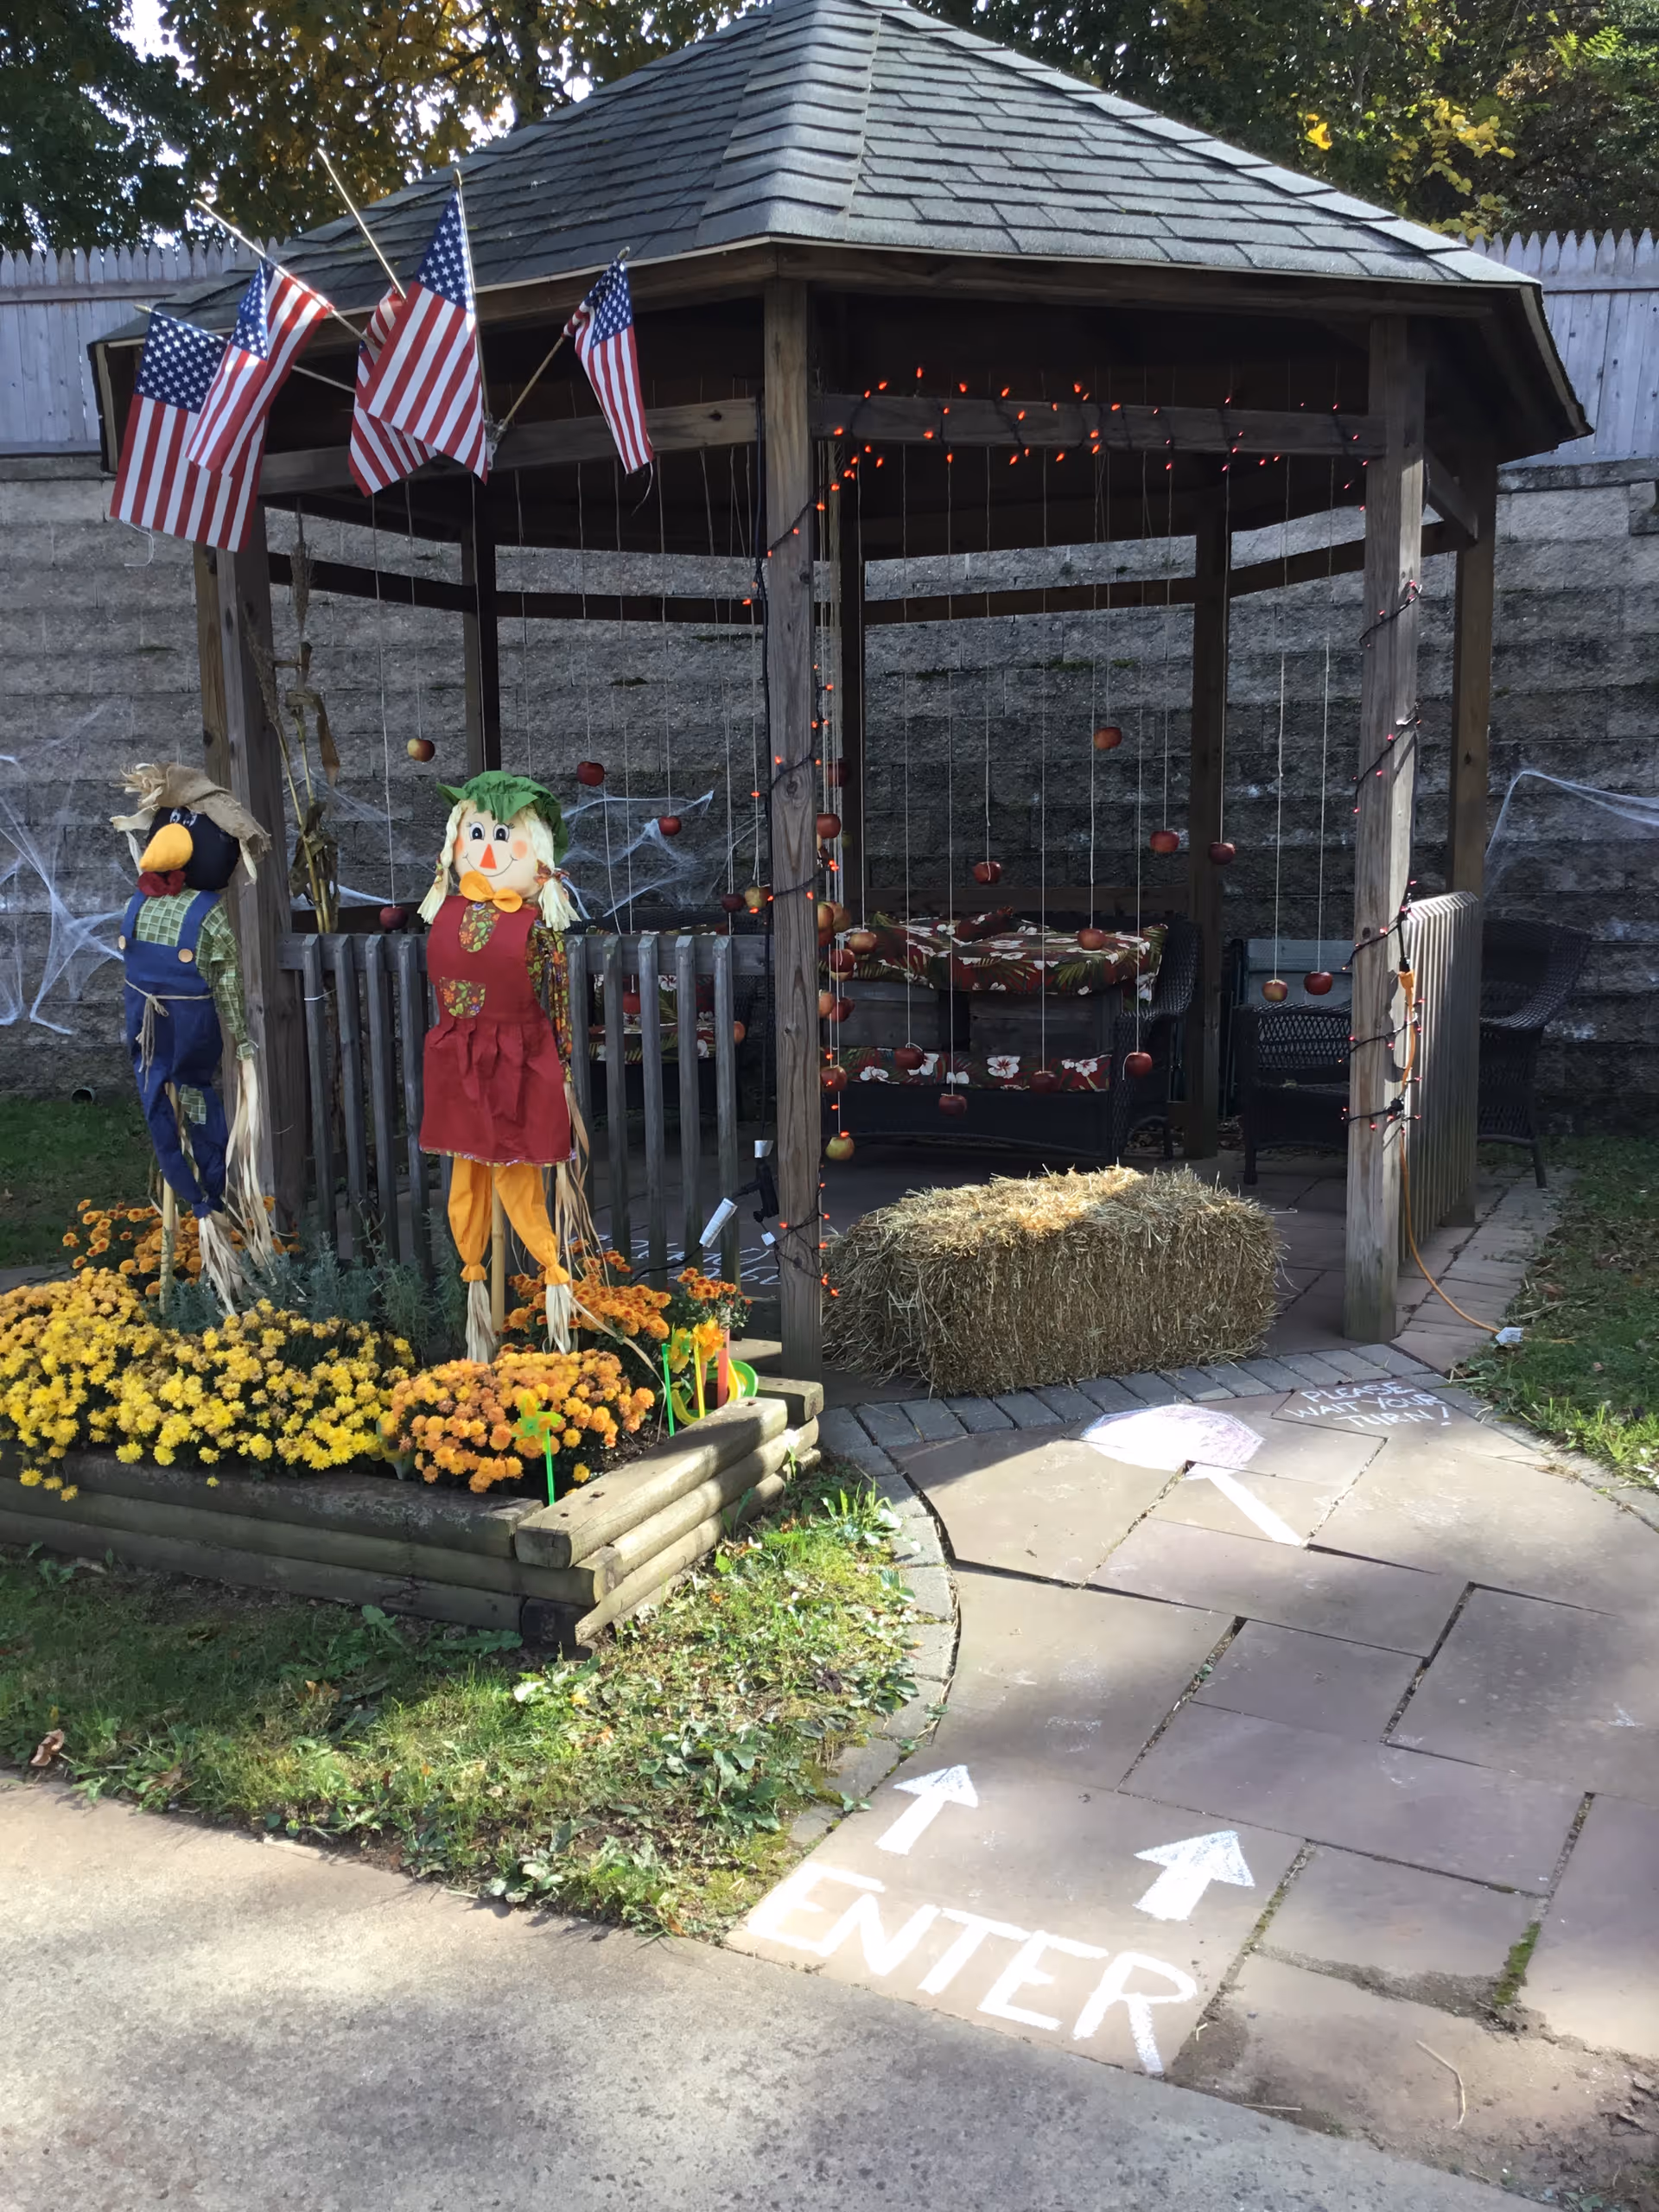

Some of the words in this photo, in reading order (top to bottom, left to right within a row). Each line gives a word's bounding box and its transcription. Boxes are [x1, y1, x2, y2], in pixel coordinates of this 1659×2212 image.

[1284, 1401, 1360, 1419] WAIT
[1361, 1392, 1447, 1411] YOUR
[1300, 1382, 1417, 1402] PLEASE
[746, 1861, 1199, 2075] ENTER
